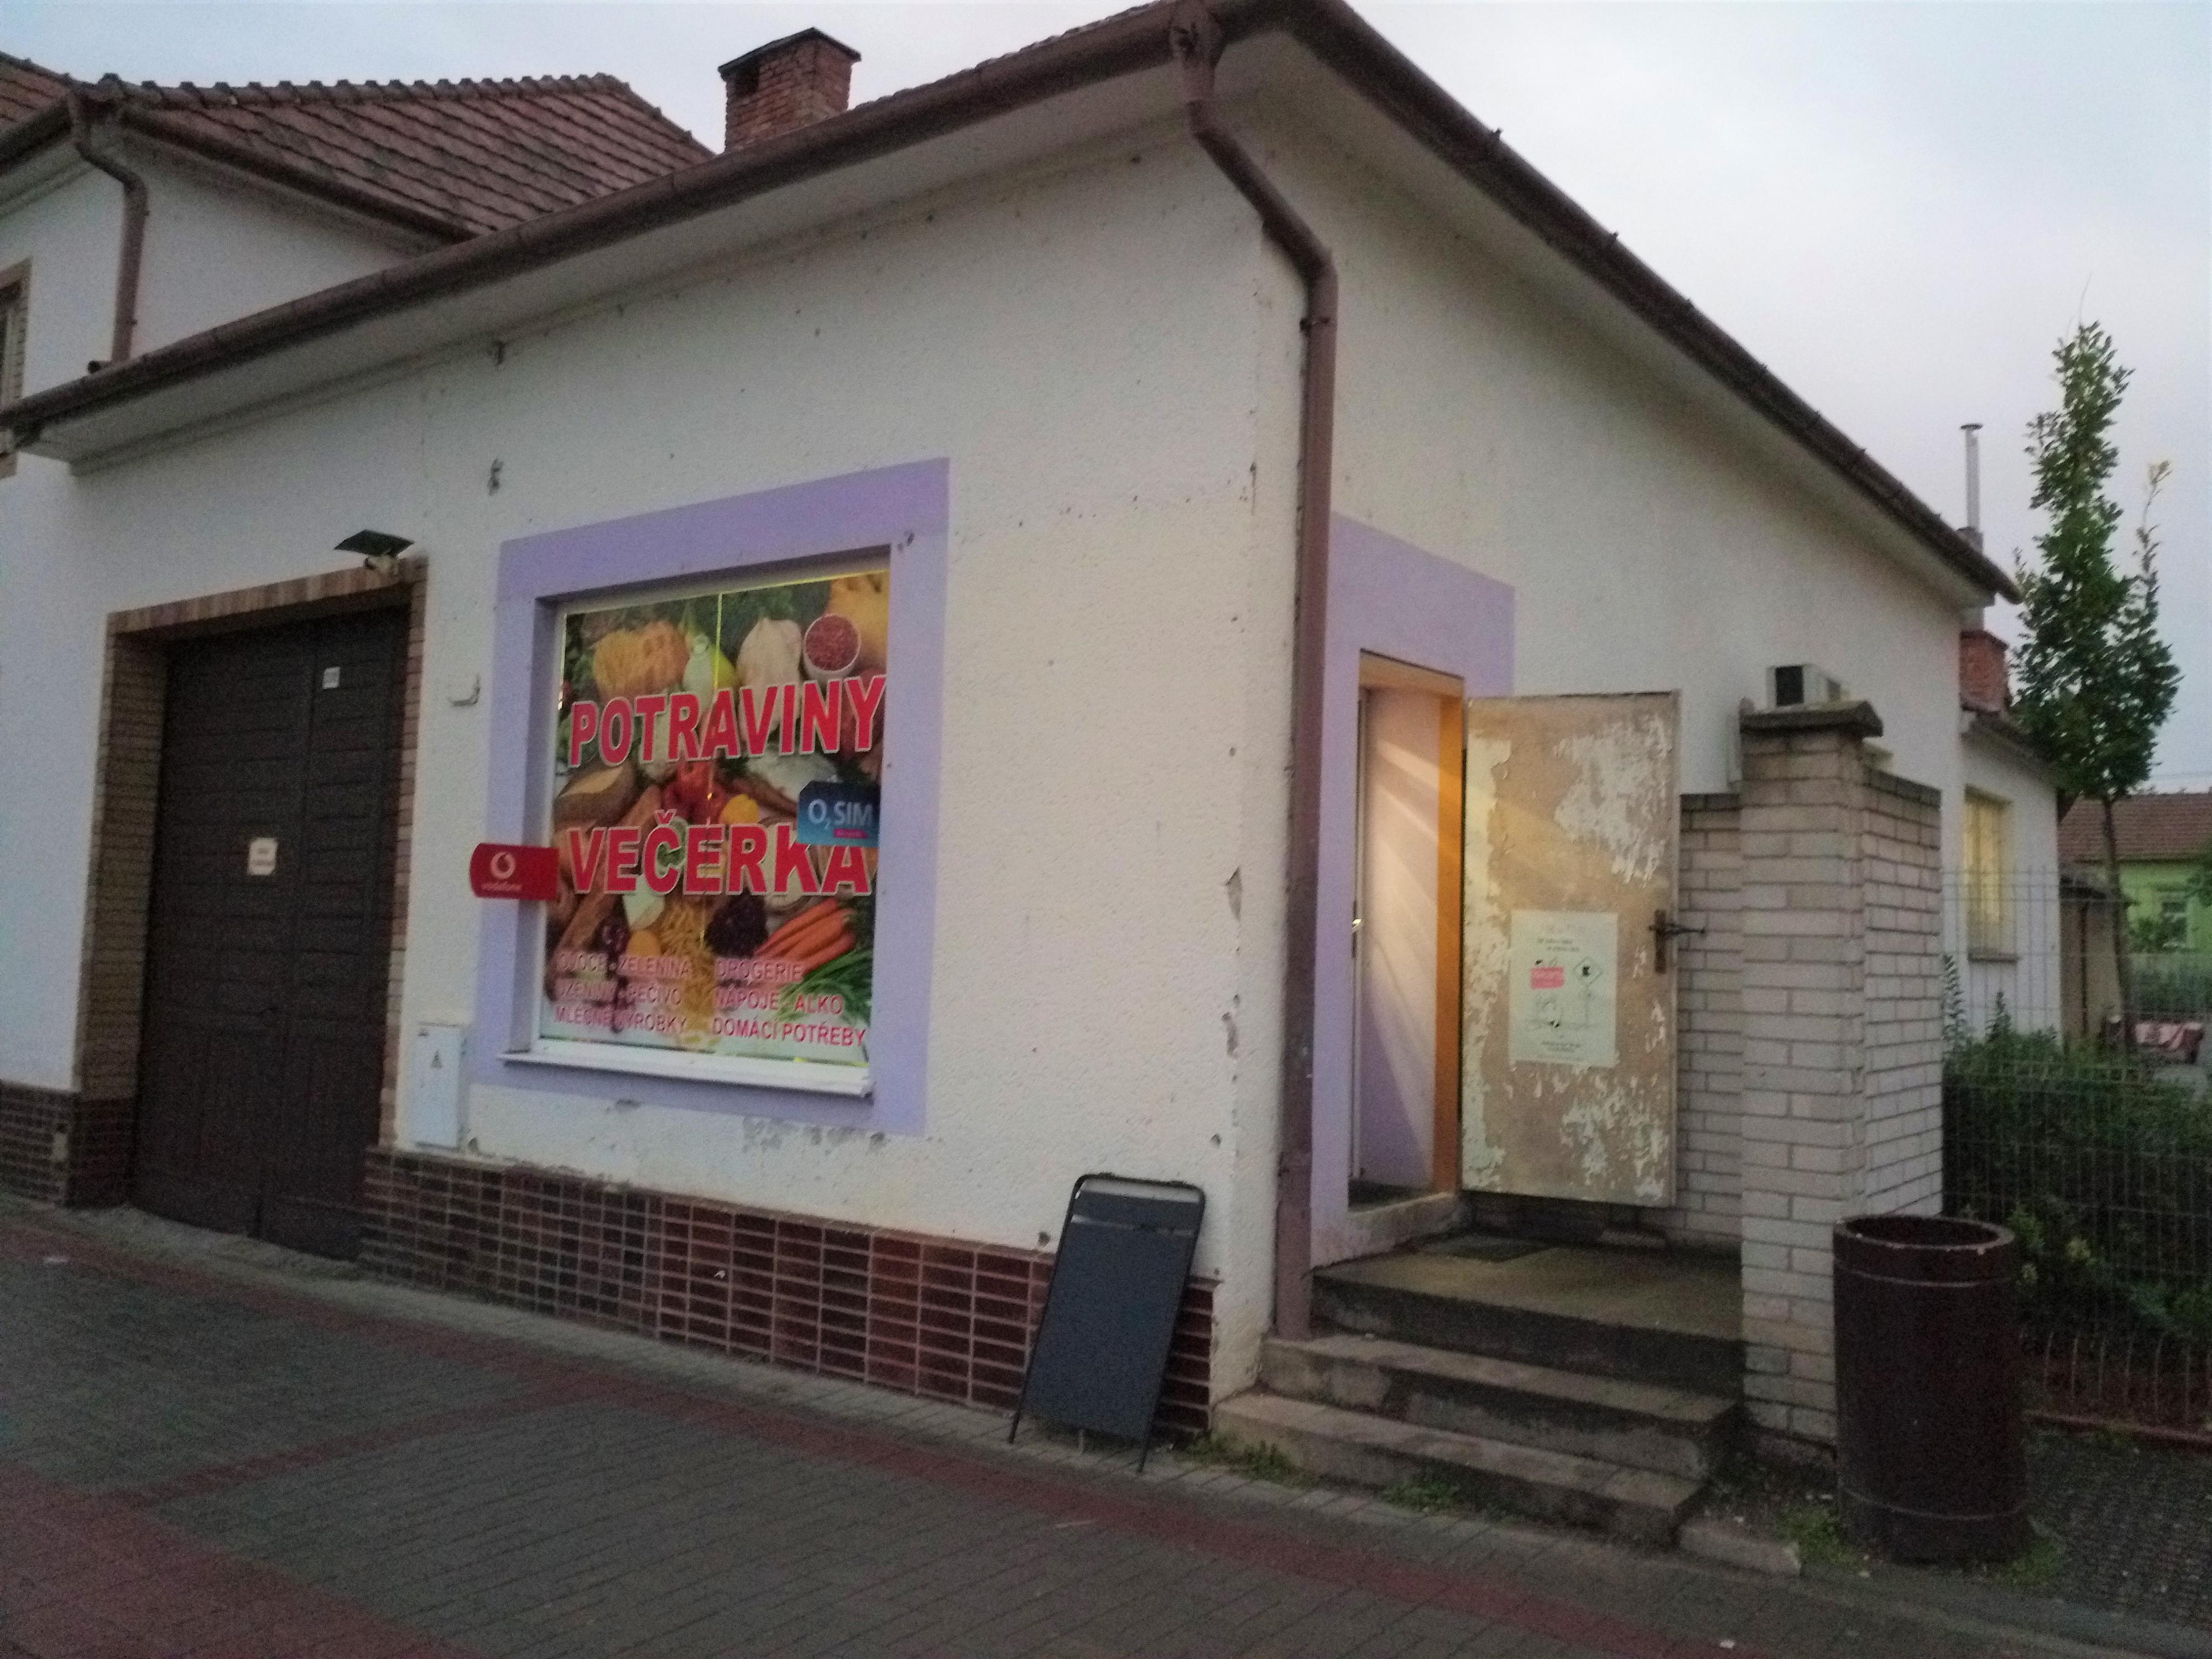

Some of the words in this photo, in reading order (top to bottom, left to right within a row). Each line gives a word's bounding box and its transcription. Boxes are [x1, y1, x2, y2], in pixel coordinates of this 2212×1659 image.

[568, 674, 886, 766] POTRAVINY
[833, 801, 873, 826] SIM
[567, 810, 872, 896] VEČERKA
[556, 952, 607, 972] OVOCE
[618, 956, 692, 977] ZELENINA
[715, 959, 804, 983] DROGERIE
[714, 983, 780, 1011] NÁPOJE
[795, 993, 844, 1015] ALKO
[712, 1014, 778, 1040] DOMÁCÍ
[781, 1020, 867, 1046] POTŘEBY
